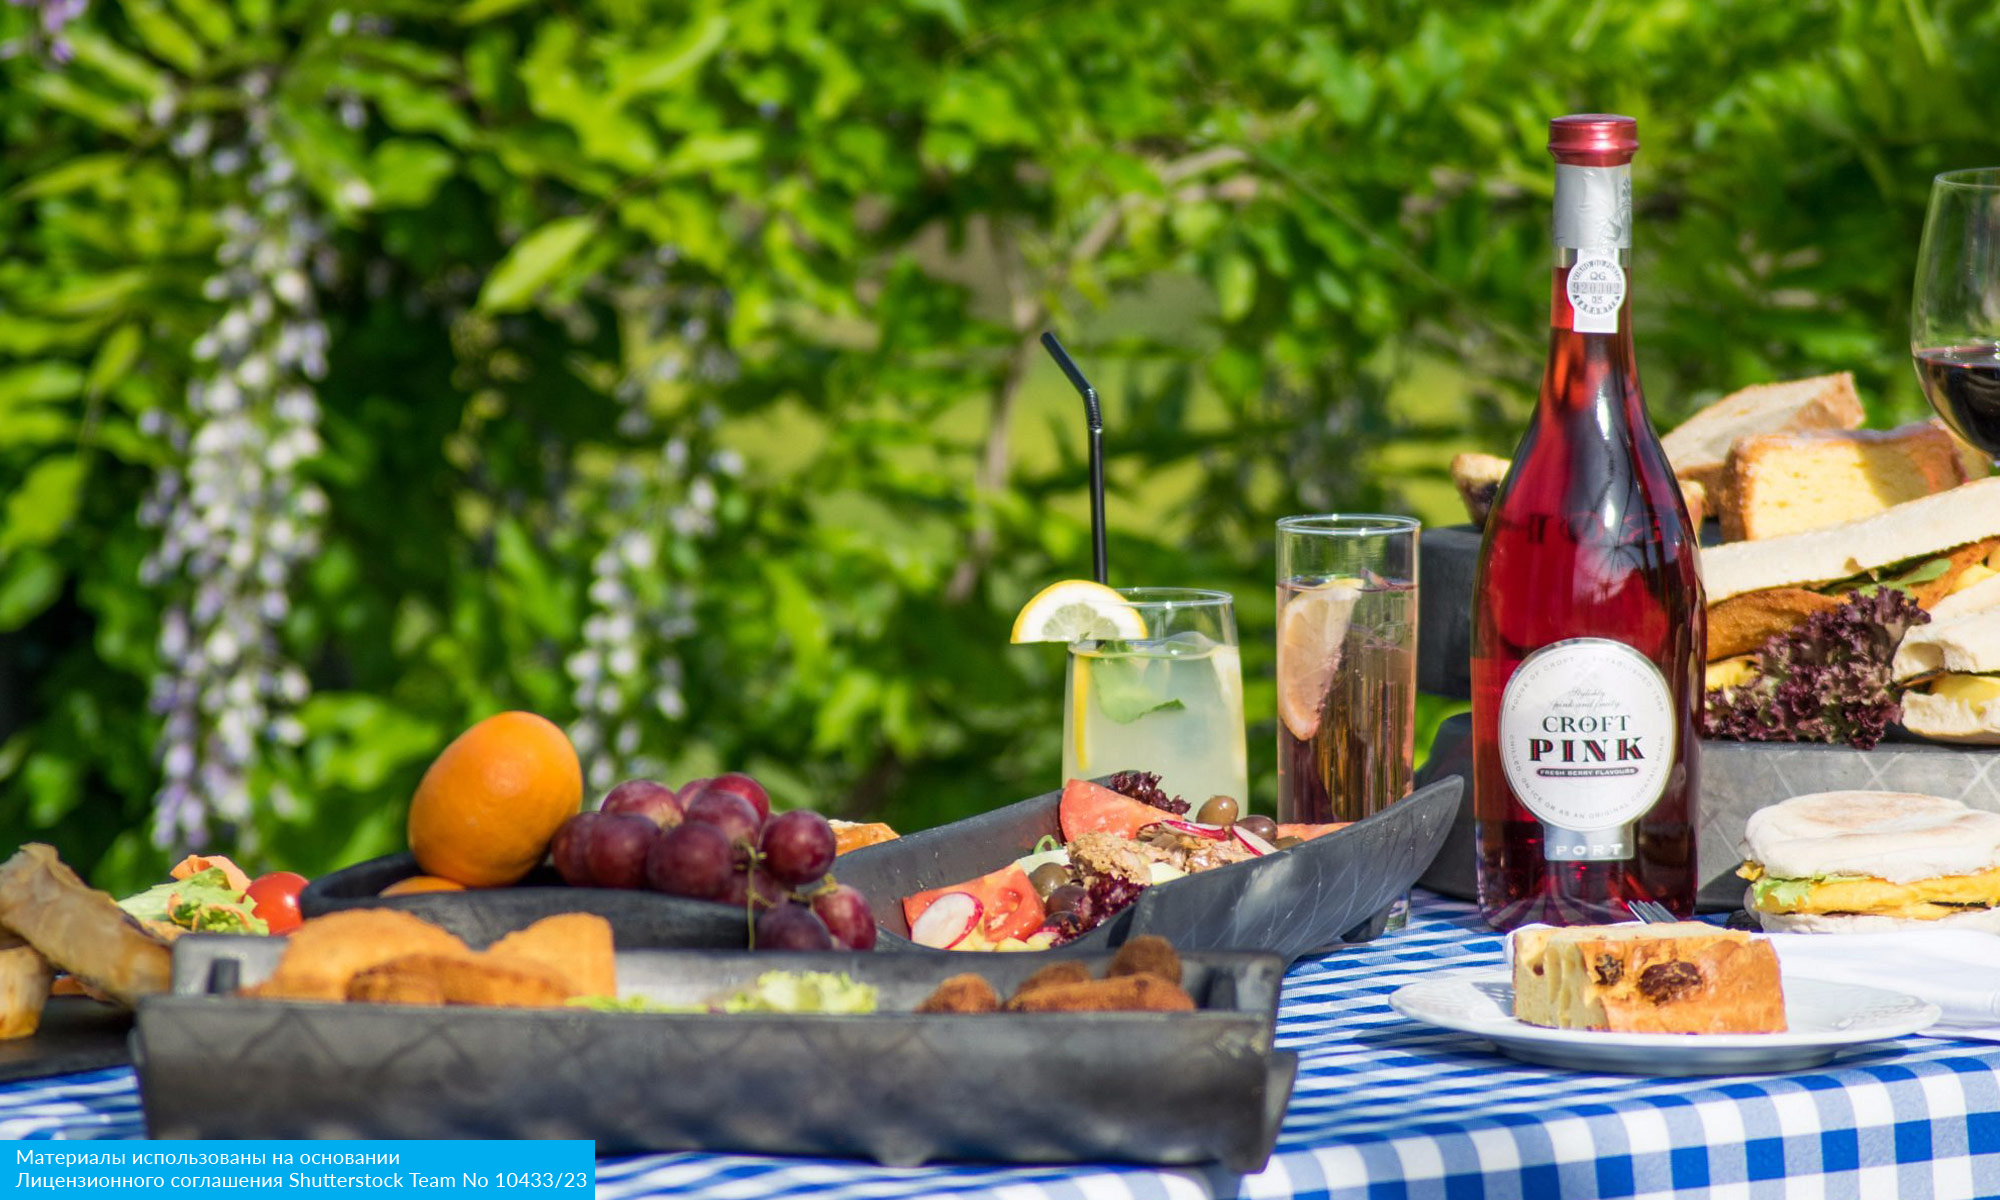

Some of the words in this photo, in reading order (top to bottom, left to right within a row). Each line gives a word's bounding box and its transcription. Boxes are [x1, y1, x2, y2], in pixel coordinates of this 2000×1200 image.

[1590, 272, 1606, 280] QG
[1529, 670, 1539, 681] OF
[1543, 656, 1574, 671] CROFT
[1542, 716, 1631, 734] CROFT
[1528, 737, 1645, 762] PINK
[1595, 768, 1636, 776] FLAVOURS
[1555, 843, 1624, 856] PORT
